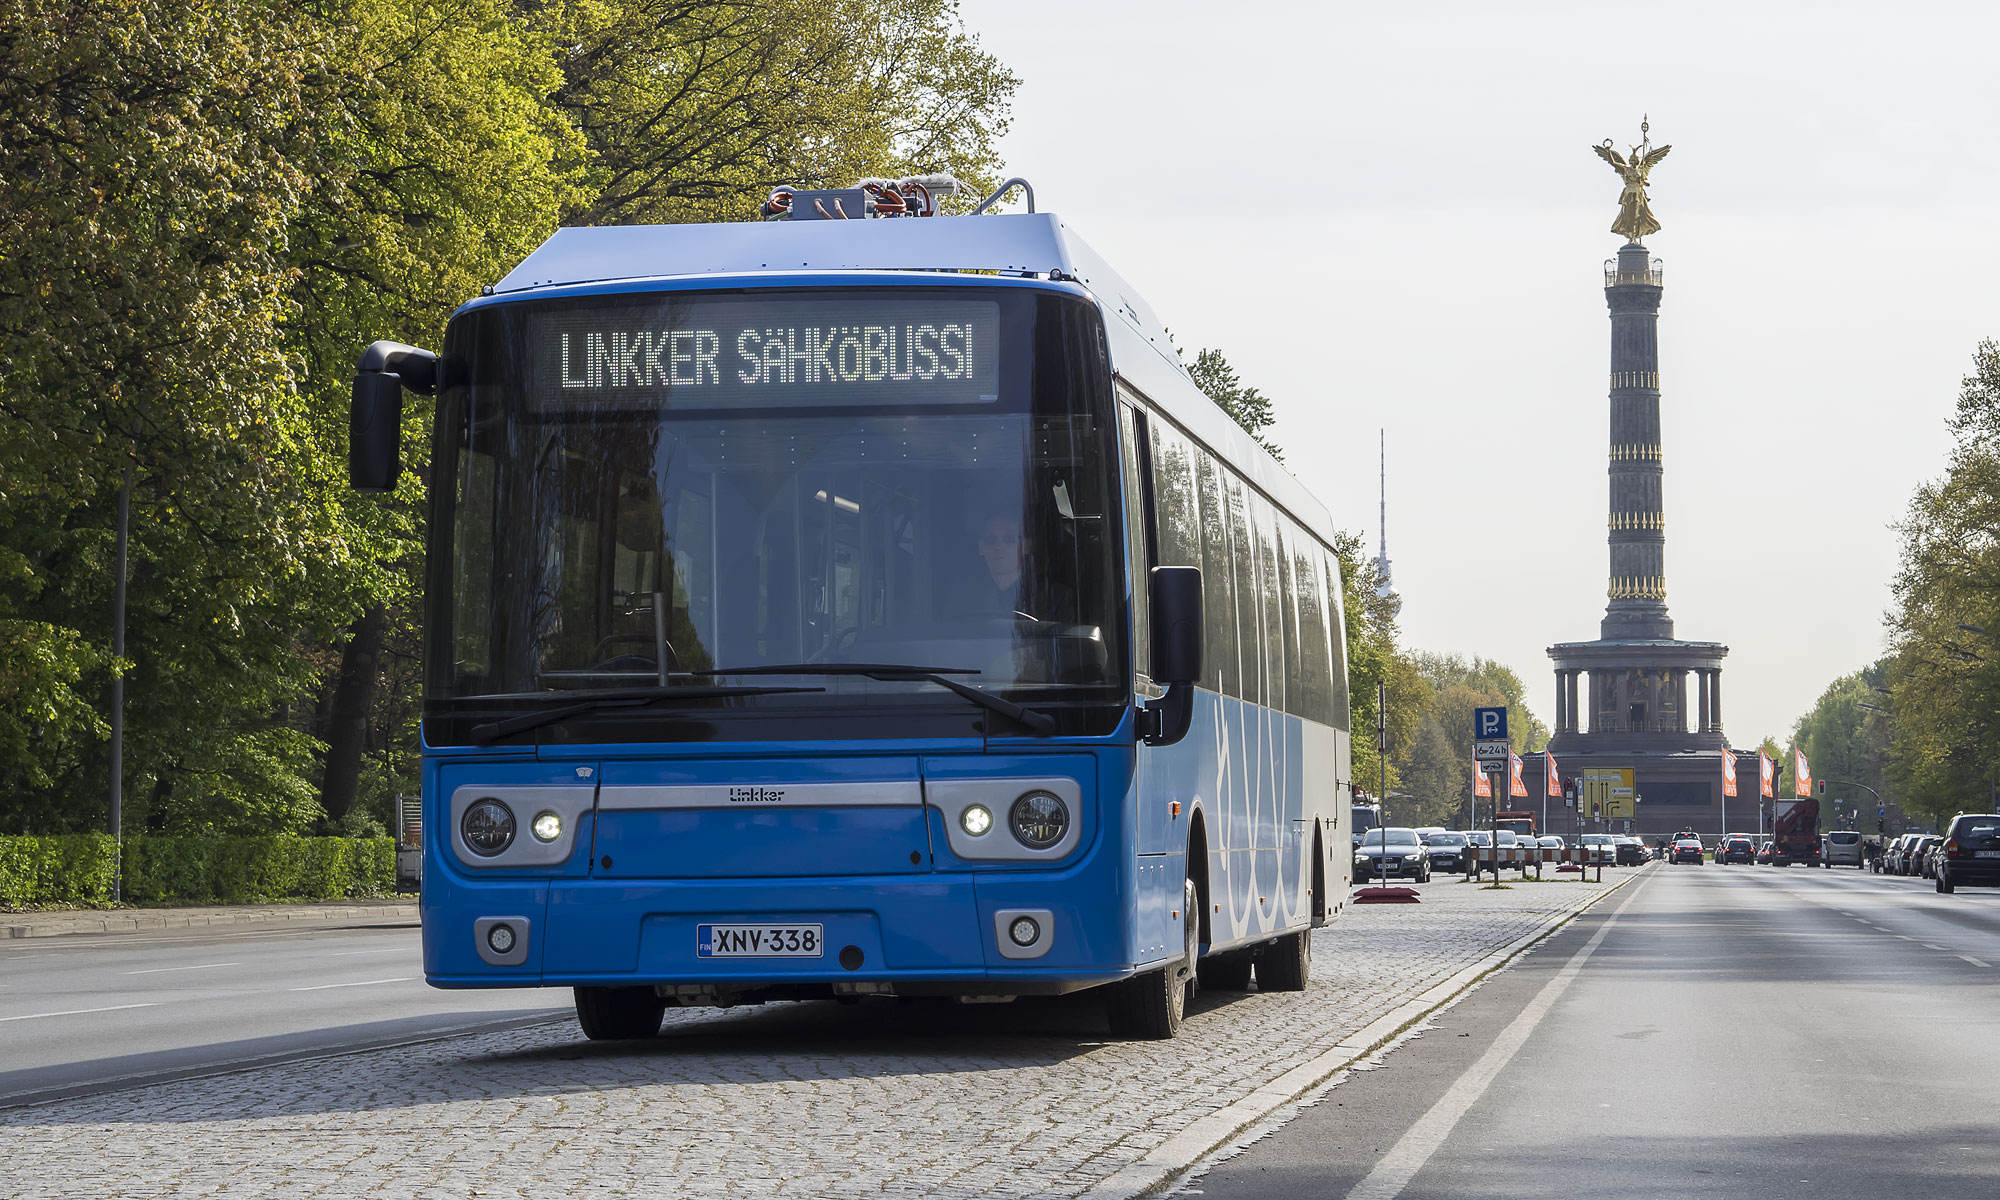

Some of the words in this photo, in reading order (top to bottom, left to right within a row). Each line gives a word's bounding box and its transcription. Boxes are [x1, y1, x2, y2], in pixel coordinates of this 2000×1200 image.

[562, 330, 720, 388] LINKKER
[737, 324, 973, 385] SÄHKÖBUSSI
[1482, 711, 1500, 736] P
[729, 787, 785, 802] Linkker
[699, 943, 712, 951] FIN
[716, 929, 816, 952] XNV-338
